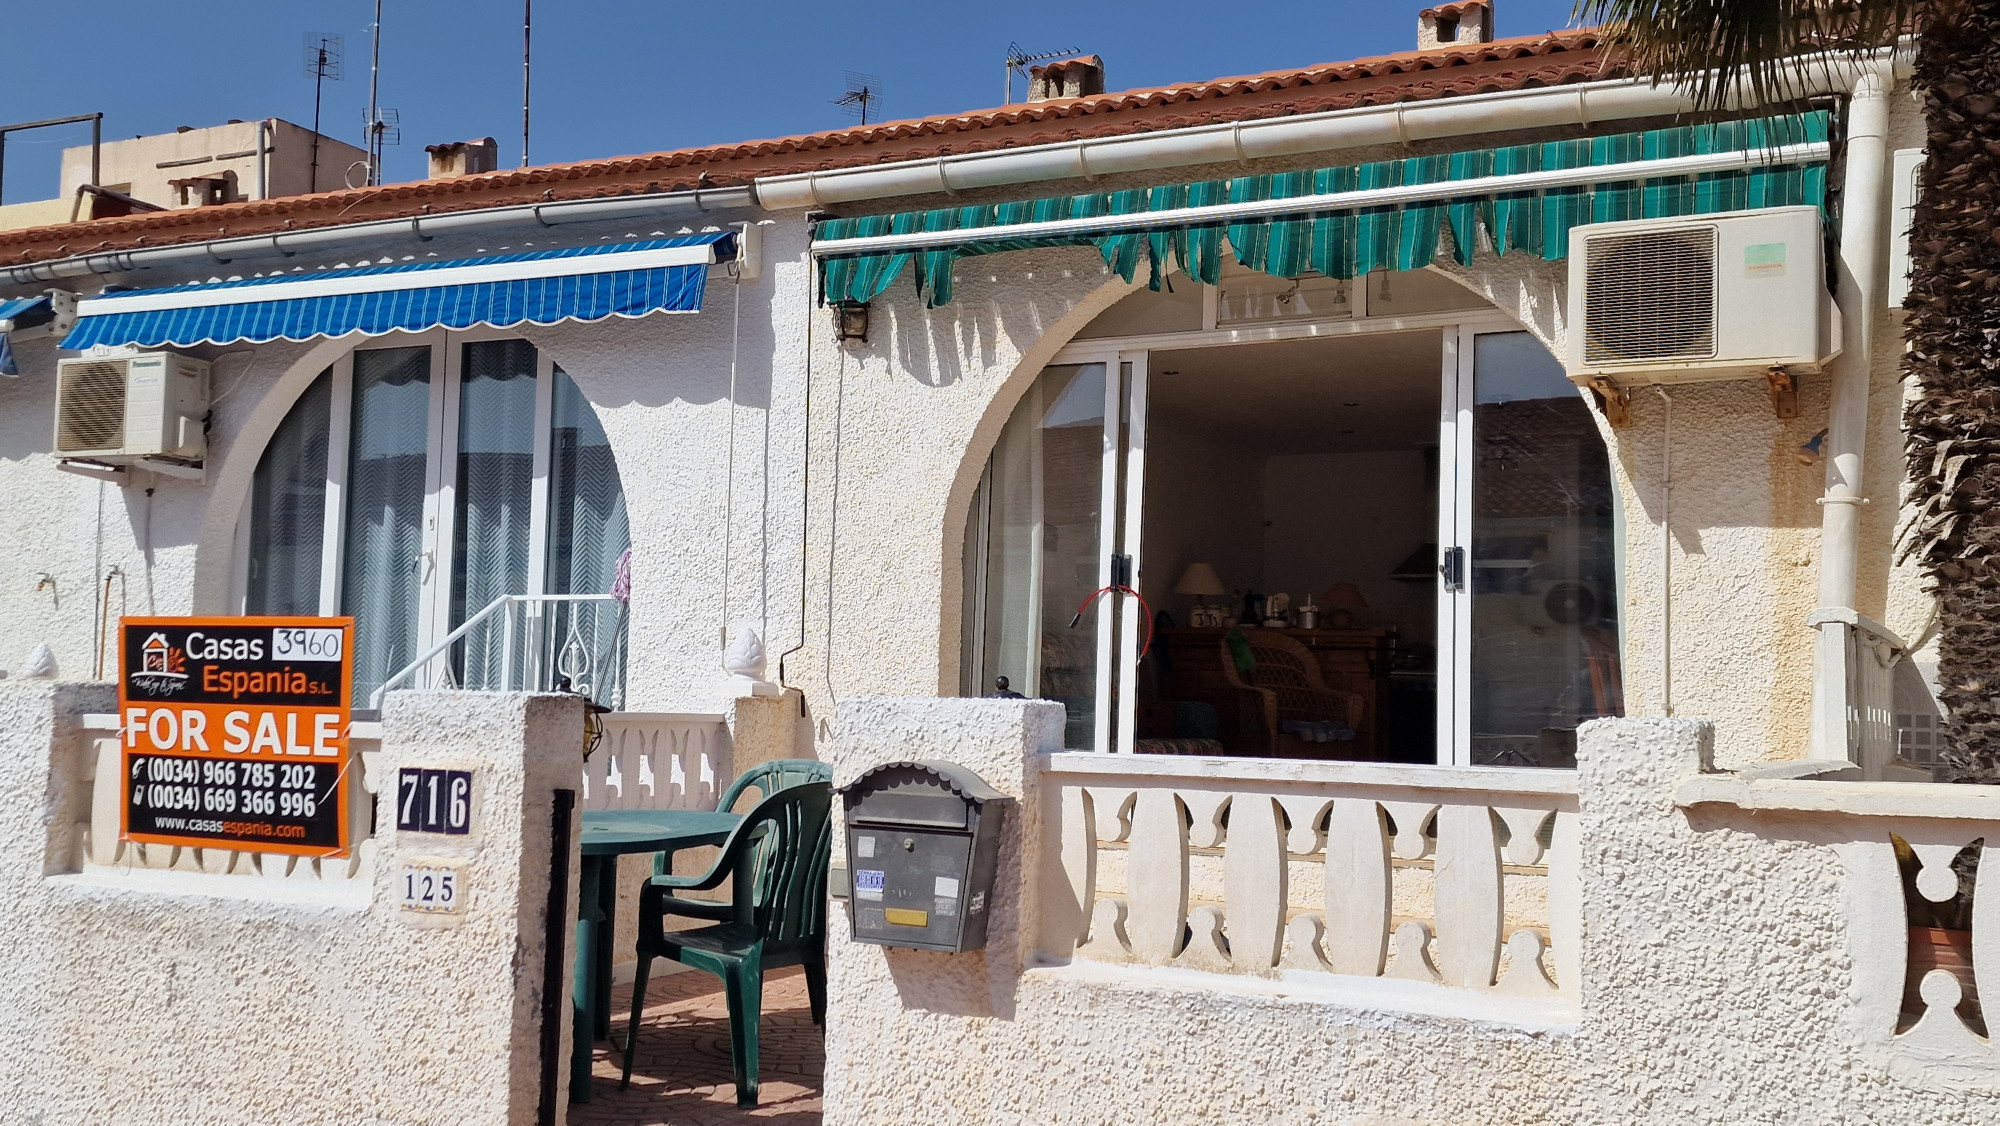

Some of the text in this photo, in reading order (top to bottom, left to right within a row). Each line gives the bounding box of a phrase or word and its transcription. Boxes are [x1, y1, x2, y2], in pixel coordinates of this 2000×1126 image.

[186, 632, 264, 660] Casas
[277, 629, 339, 657] 3960
[126, 707, 340, 757] FOR SALE
[147, 757, 316, 790] (0034) 966 785 202
[147, 784, 316, 817] (0034) 669 366 996
[400, 774, 468, 828] 716
[405, 873, 454, 902] 125
